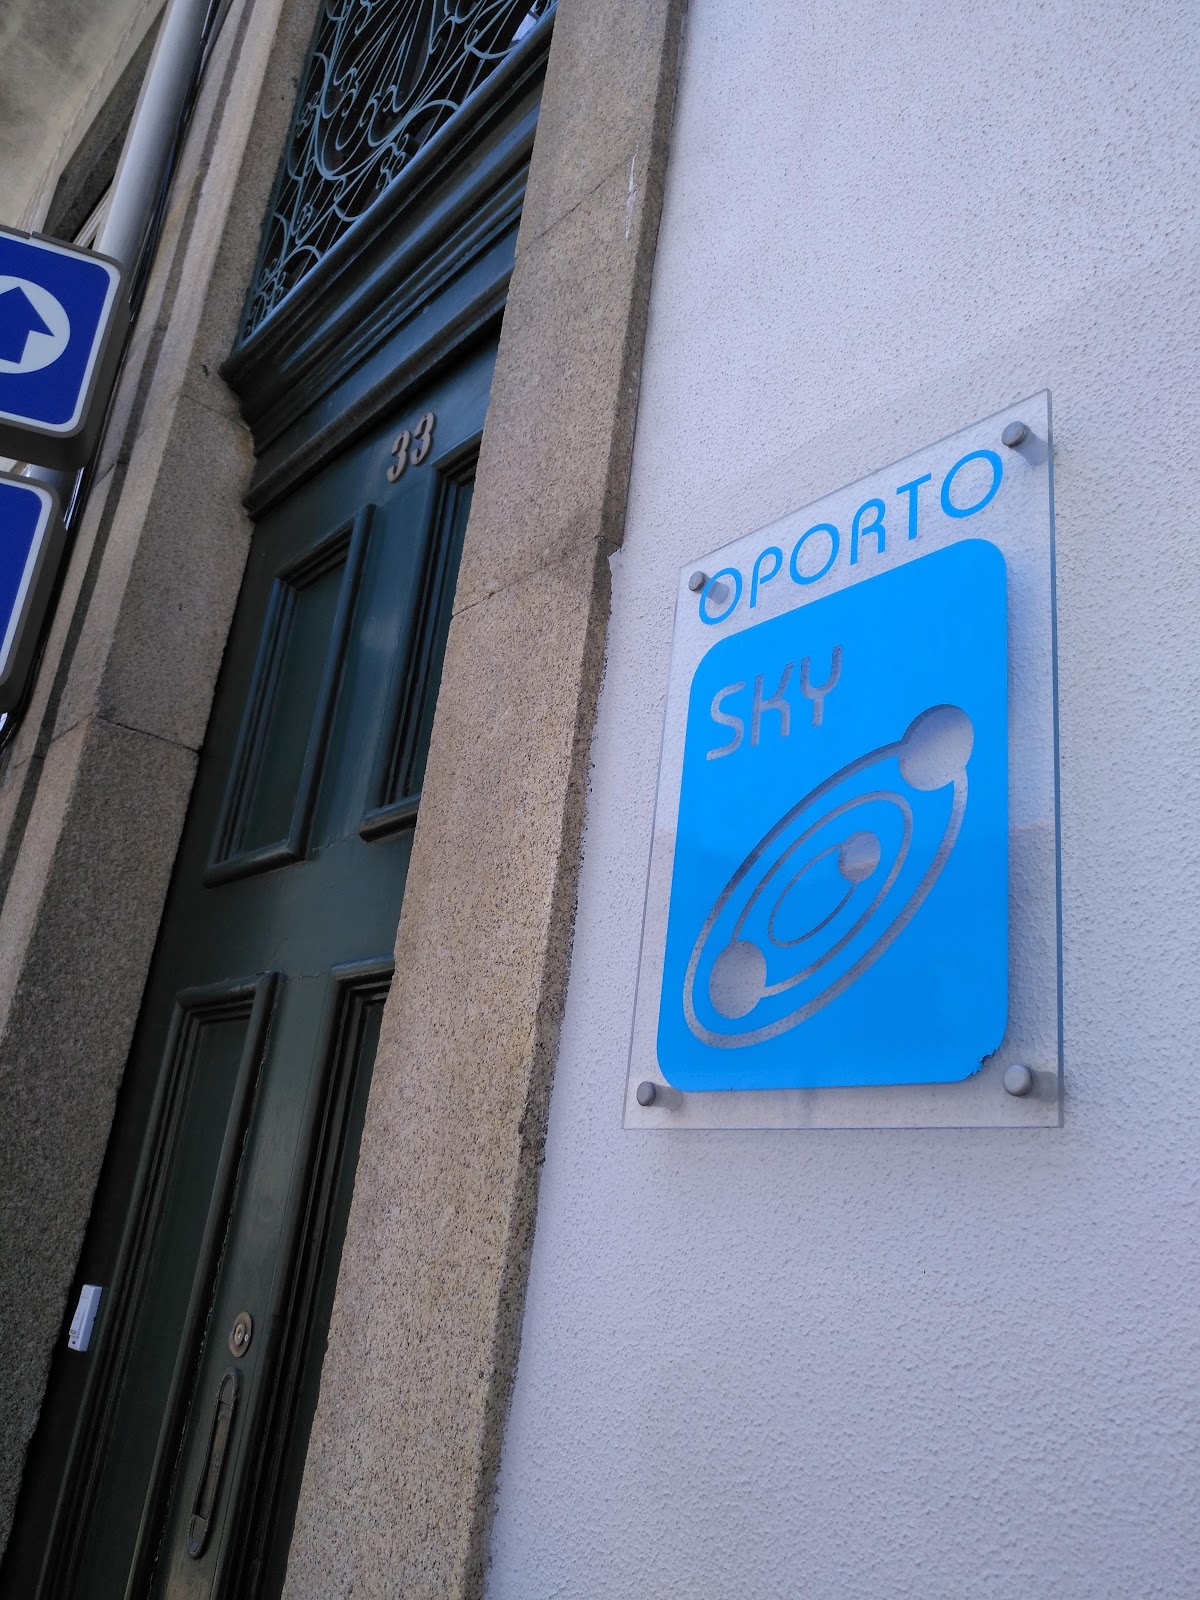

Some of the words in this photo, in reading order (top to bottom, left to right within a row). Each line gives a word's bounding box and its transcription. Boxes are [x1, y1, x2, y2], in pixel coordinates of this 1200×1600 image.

[386, 411, 435, 482] 33
[699, 449, 1003, 625] OPORTO
[706, 645, 843, 760] SKY
